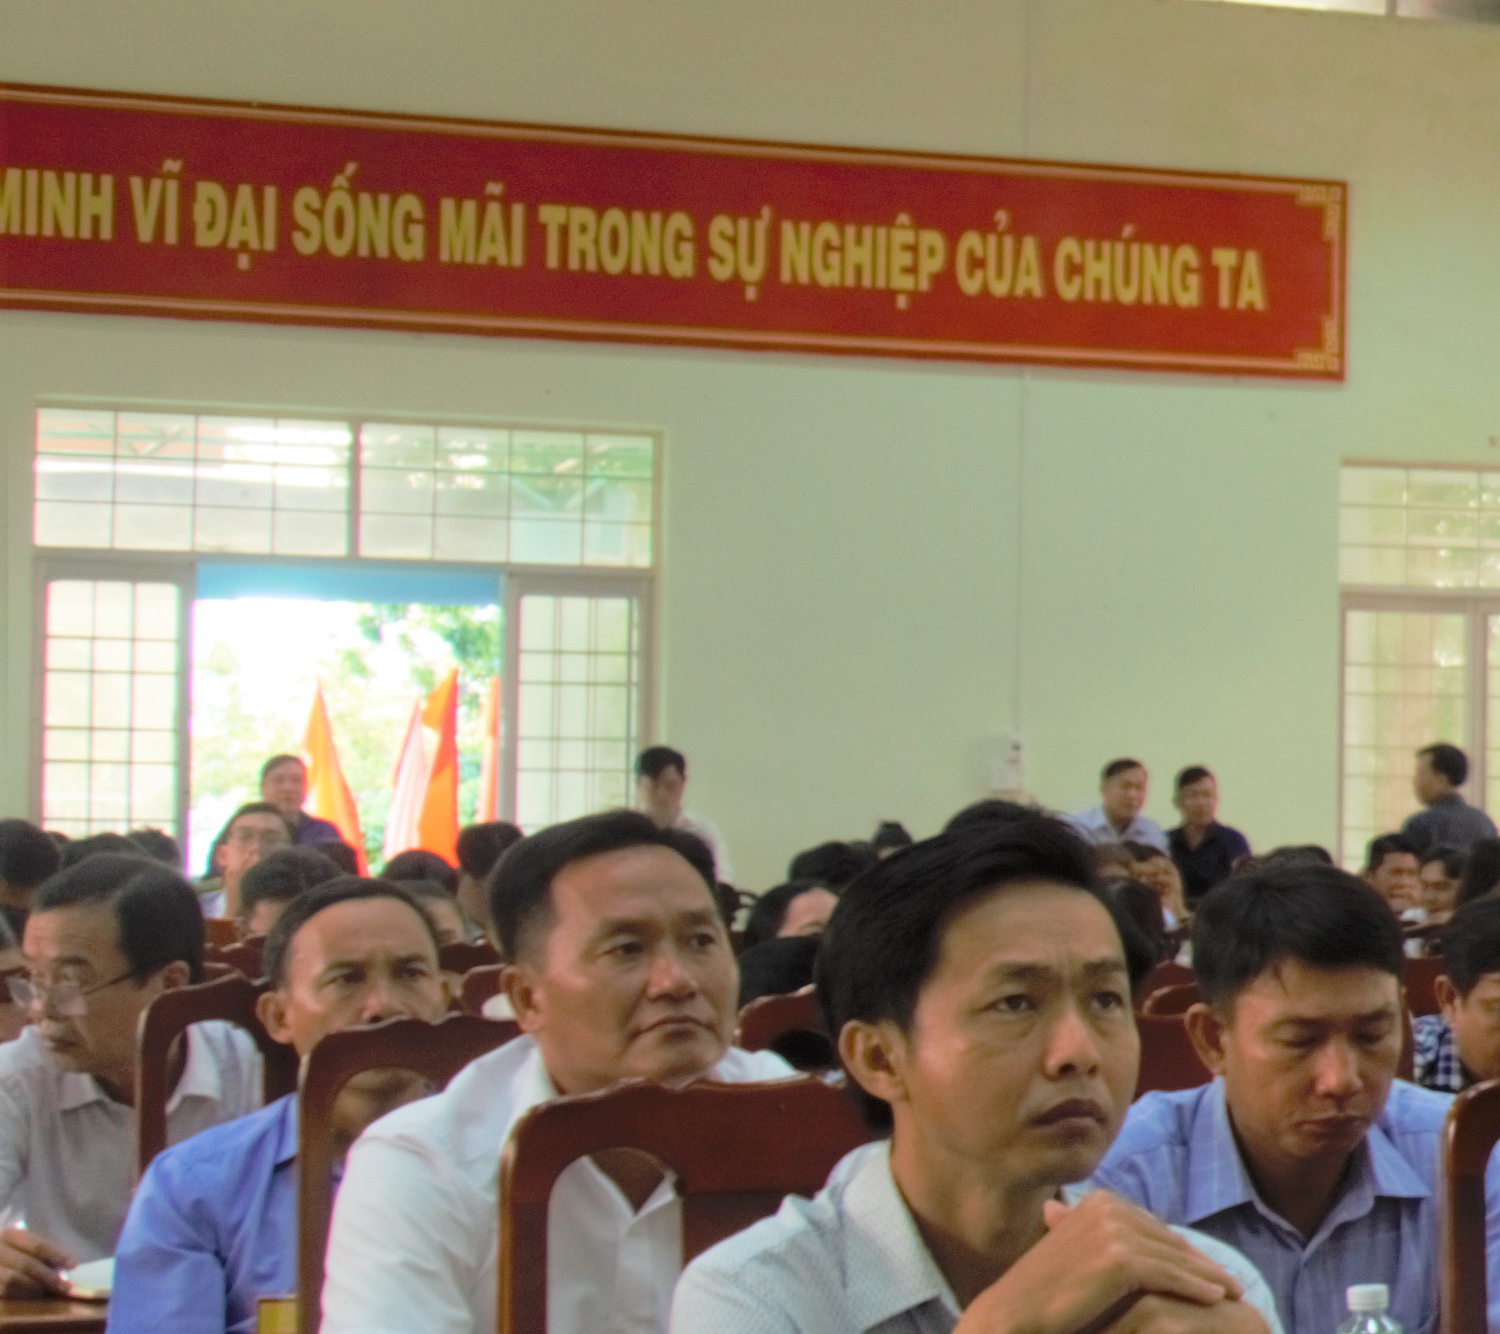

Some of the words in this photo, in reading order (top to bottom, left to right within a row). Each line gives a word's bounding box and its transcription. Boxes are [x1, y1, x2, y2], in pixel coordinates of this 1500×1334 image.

[130, 158, 183, 245] VĨ
[194, 181, 277, 269] ĐẠI
[292, 162, 425, 261] SỐNG
[440, 181, 524, 267] MÃI
[540, 204, 694, 279] TRONG
[708, 205, 772, 301] SỰ
[780, 212, 946, 310] NGHIỆP
[956, 209, 1043, 298] CỦA
[1054, 225, 1199, 307] CHÚNG
[1212, 248, 1266, 311] TA
